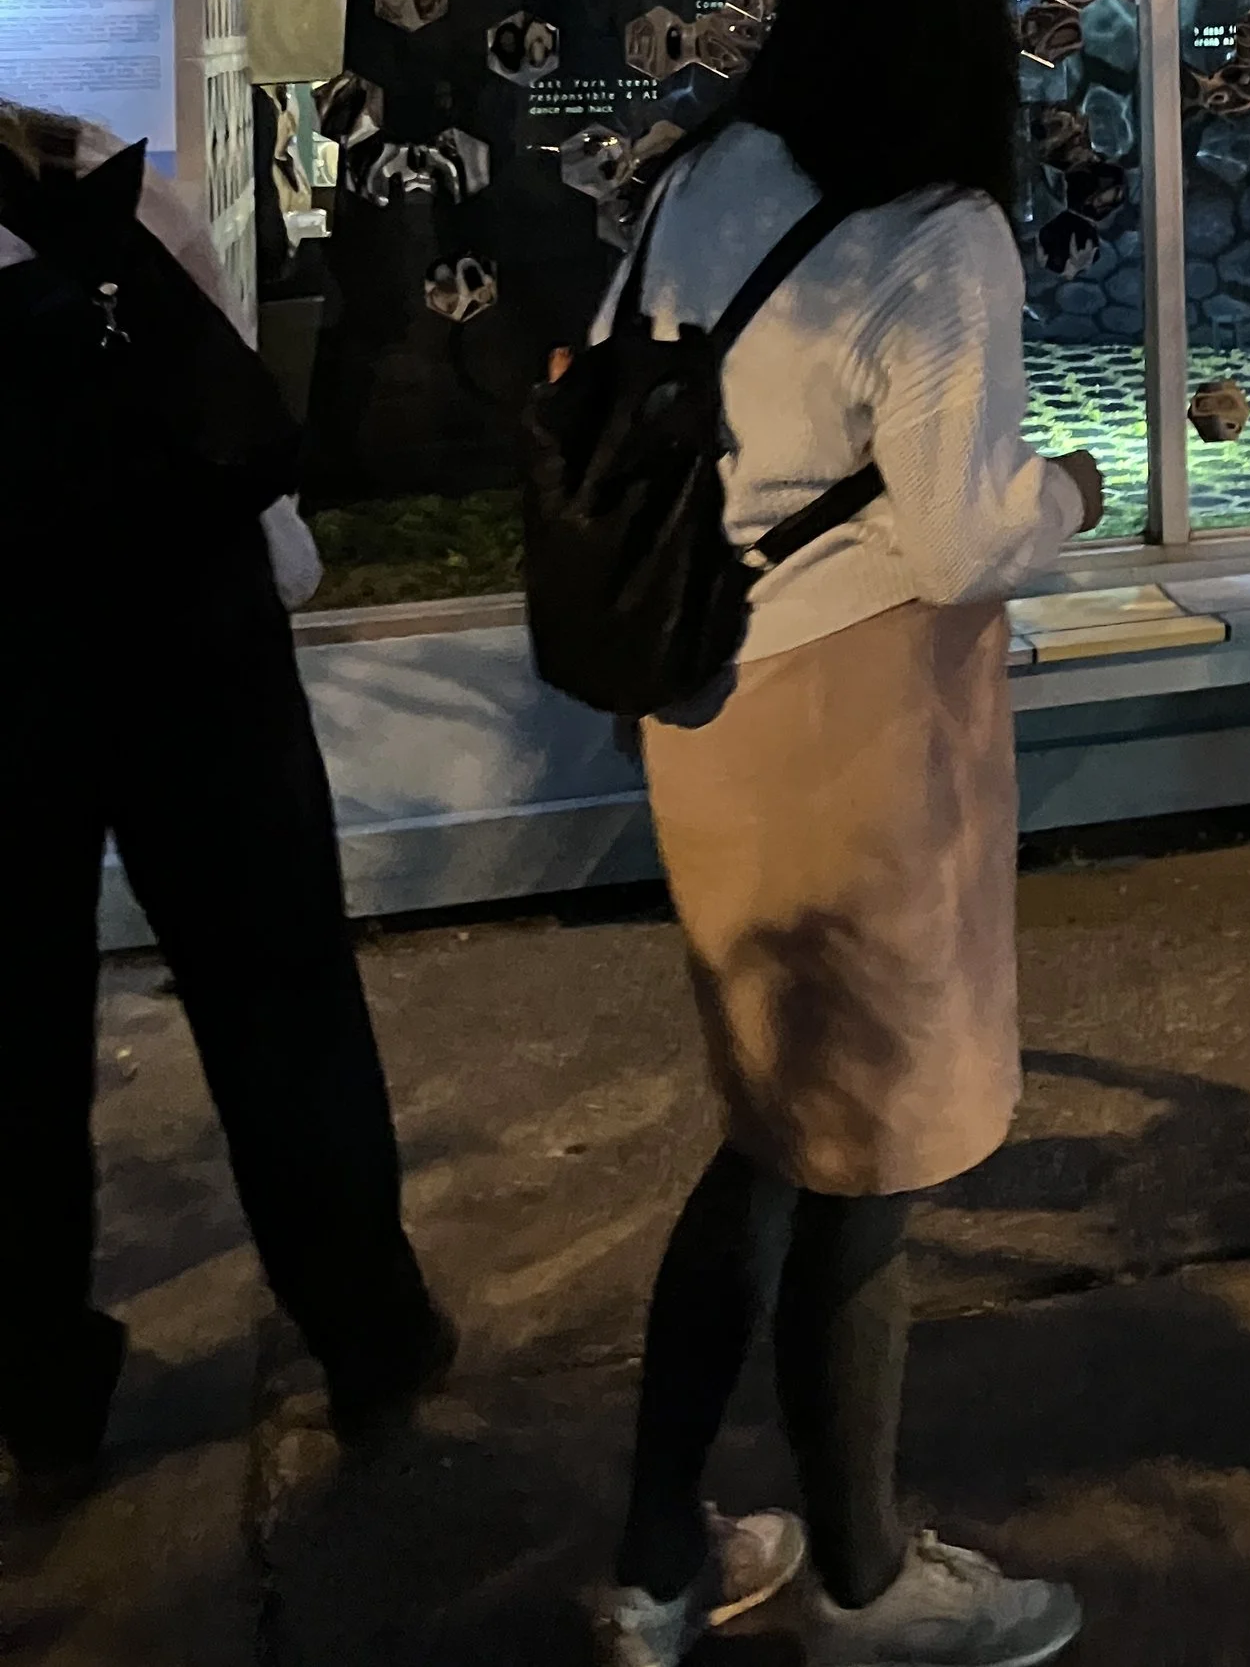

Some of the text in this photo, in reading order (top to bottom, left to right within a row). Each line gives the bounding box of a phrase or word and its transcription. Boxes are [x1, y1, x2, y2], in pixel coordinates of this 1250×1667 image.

[695, 0, 724, 9] Comm
[574, 79, 606, 88] York
[617, 79, 658, 87] teens
[529, 92, 615, 102] responsible
[642, 90, 658, 100] AI
